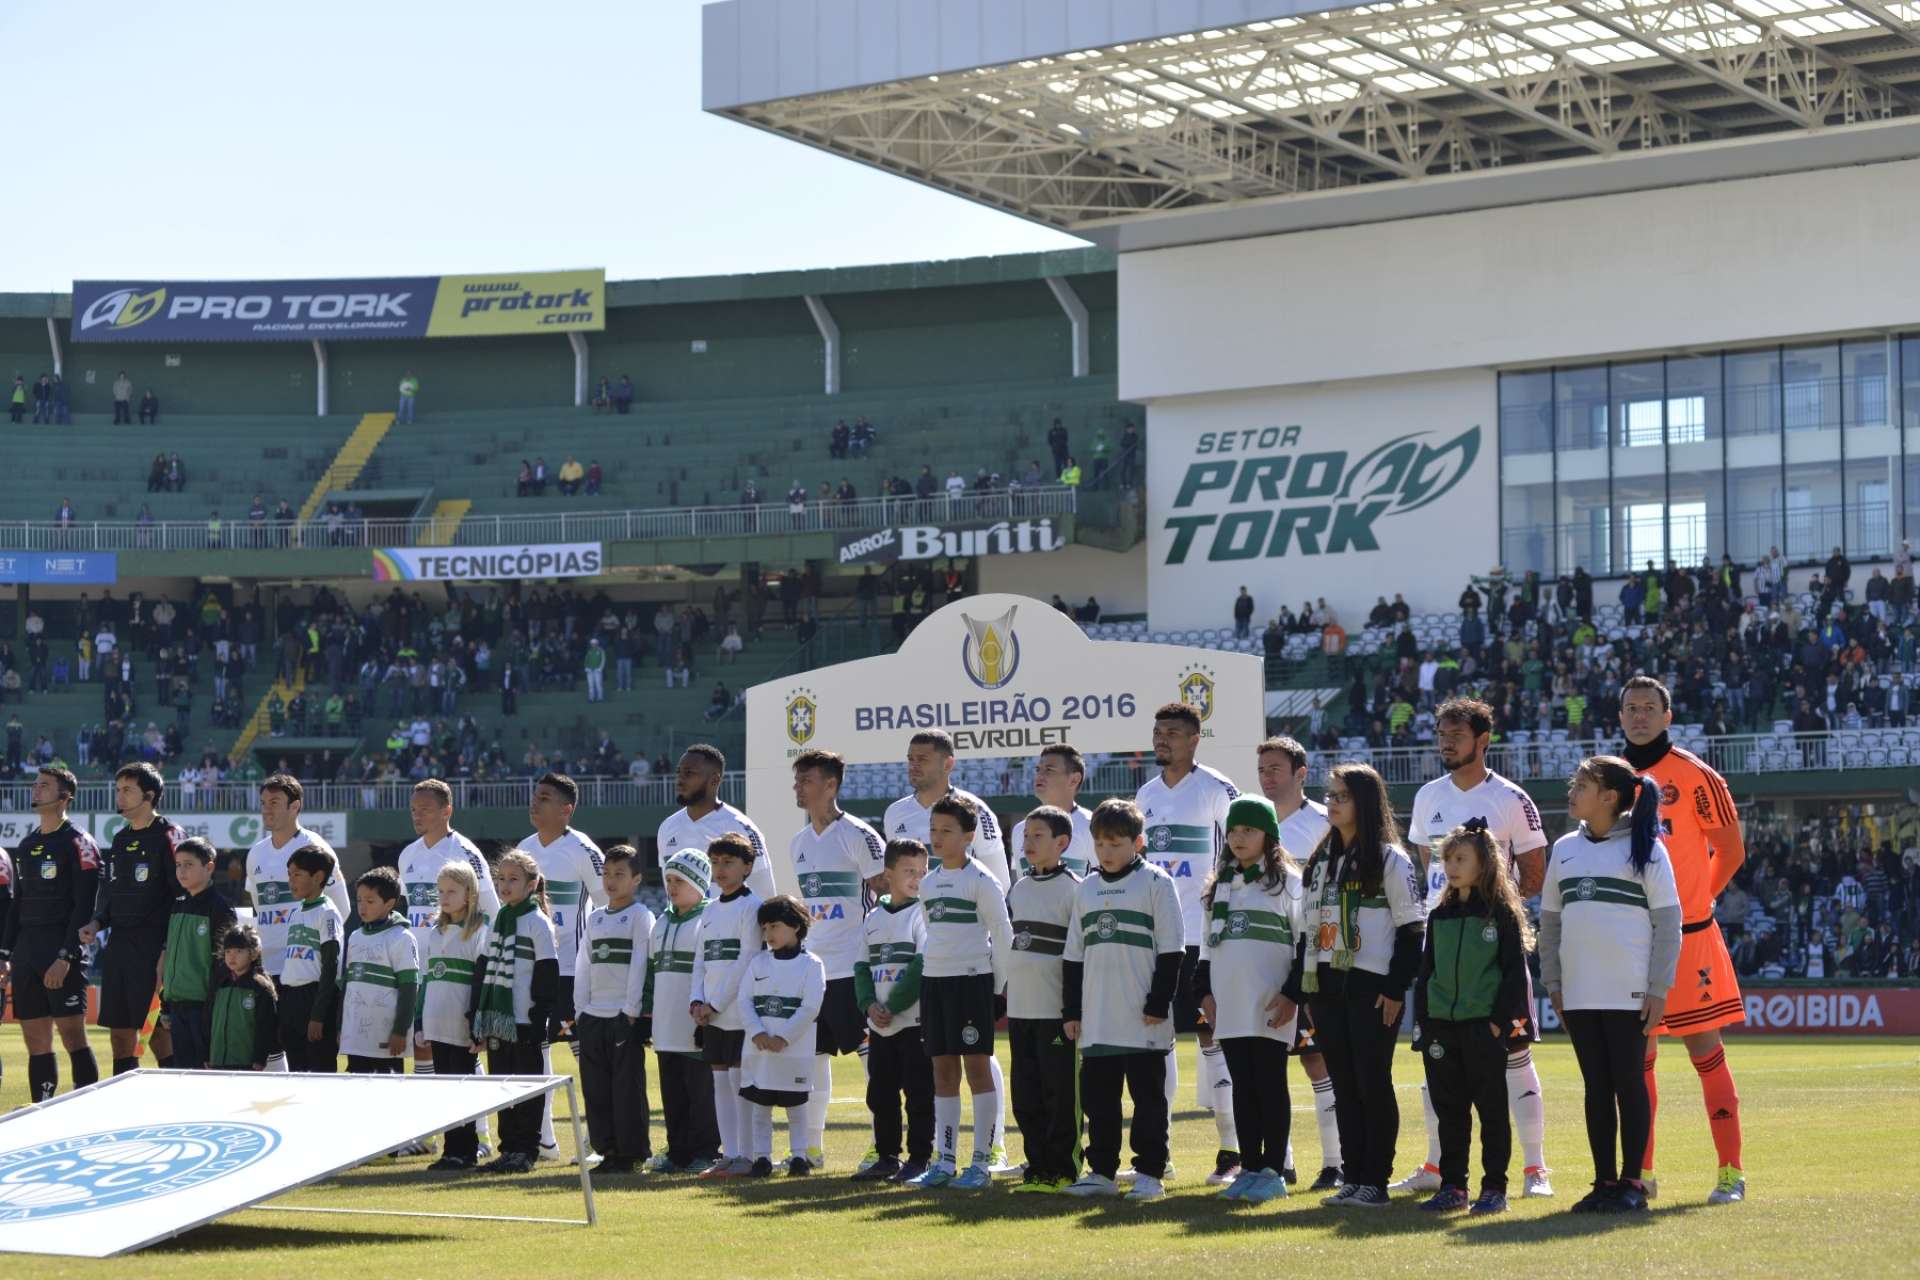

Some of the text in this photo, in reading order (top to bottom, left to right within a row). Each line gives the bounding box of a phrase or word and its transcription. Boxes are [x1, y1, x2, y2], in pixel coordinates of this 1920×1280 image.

[463, 281, 523, 293] www.
[168, 292, 412, 320] PRO TORK
[461, 288, 593, 318] protork
[253, 320, 407, 331] RACING DEVELOPMENT
[536, 311, 593, 325] .com
[1196, 425, 1302, 454] SETOR
[1172, 451, 1348, 509] PRO
[839, 518, 1066, 564] ARROZ Buriti
[1164, 500, 1394, 565] TORK
[45, 559, 86, 570] NET
[418, 548, 599, 577] TECNICÓPIAS
[855, 692, 1136, 731] BRASILEIRÃO 2016
[952, 726, 1071, 750] EVROLET
[1200, 728, 1215, 738] SIL
[134, 1126, 235, 1139] FOOT
